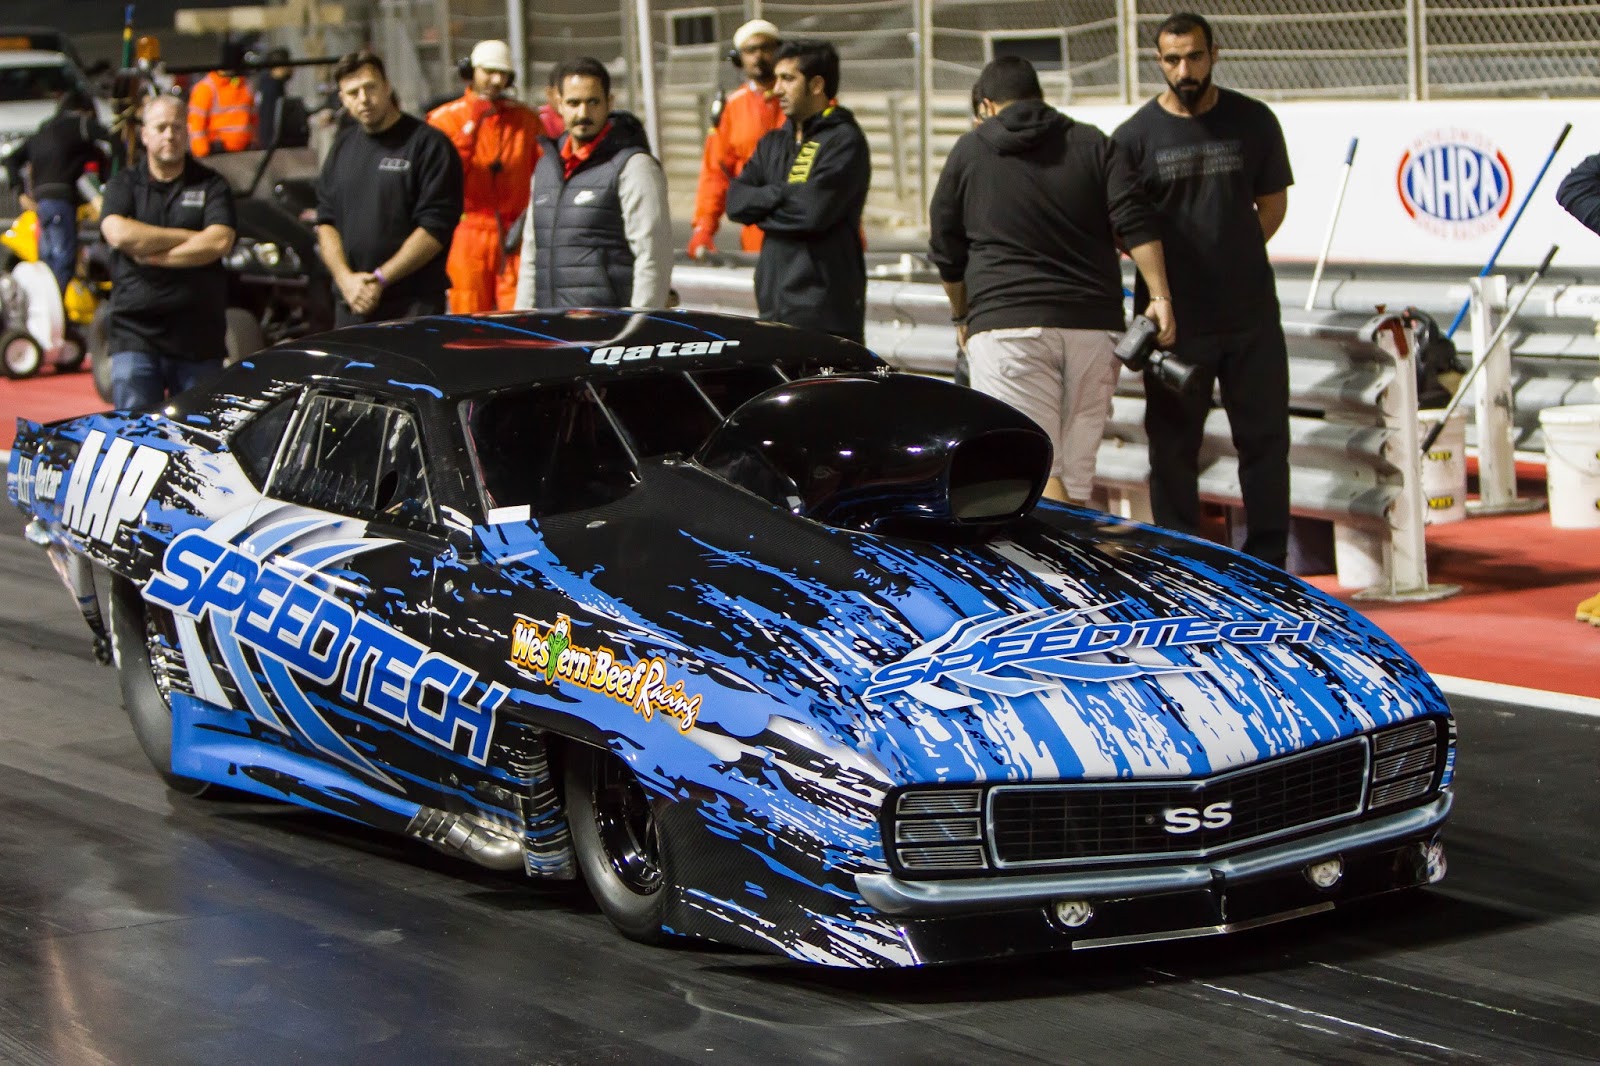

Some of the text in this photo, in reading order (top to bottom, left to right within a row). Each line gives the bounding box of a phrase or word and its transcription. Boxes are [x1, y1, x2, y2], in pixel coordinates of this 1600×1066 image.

[1411, 145, 1500, 219] NHRA
[590, 340, 740, 365] Qatar
[62, 429, 169, 545] AAP
[141, 528, 511, 766] SPEEDTECH
[512, 619, 701, 730] Western Beef Racing
[862, 619, 1321, 699] SPEEDTECH
[1163, 801, 1232, 834] SS
